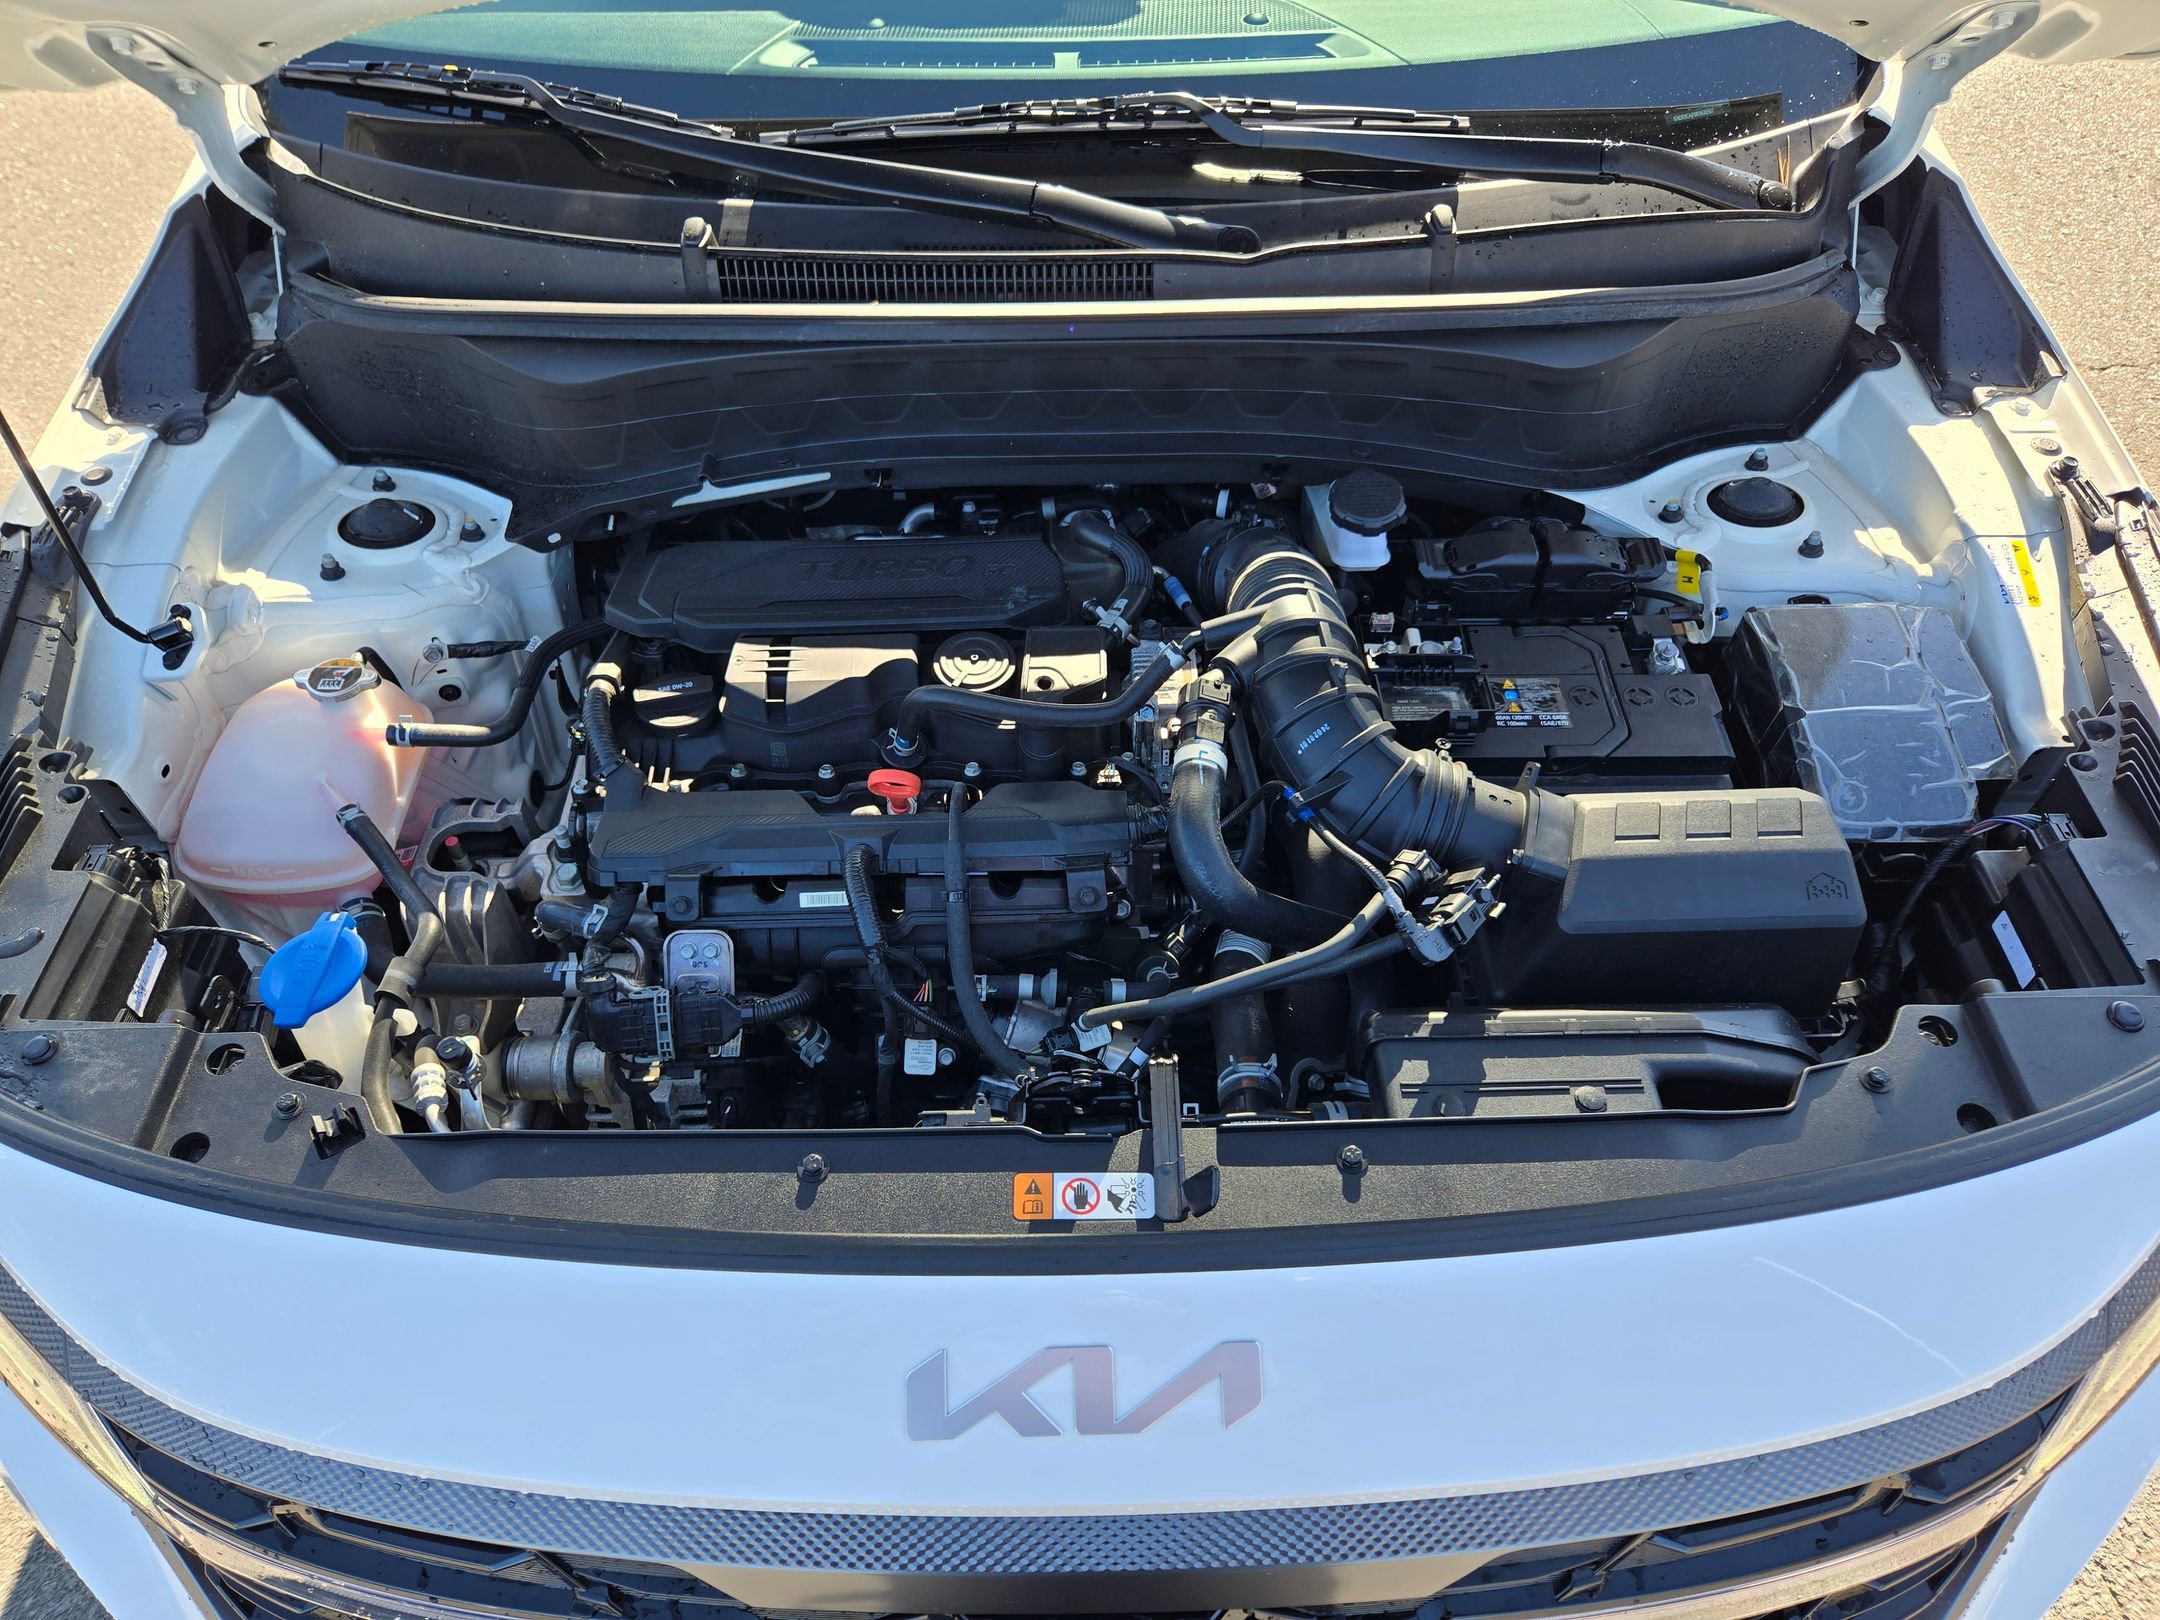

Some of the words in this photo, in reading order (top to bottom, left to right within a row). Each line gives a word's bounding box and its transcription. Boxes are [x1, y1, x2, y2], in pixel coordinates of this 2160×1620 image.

[797, 557, 974, 584] TURBO
[671, 681, 693, 690] 0W-20
[905, 1339, 1264, 1442] KIA
